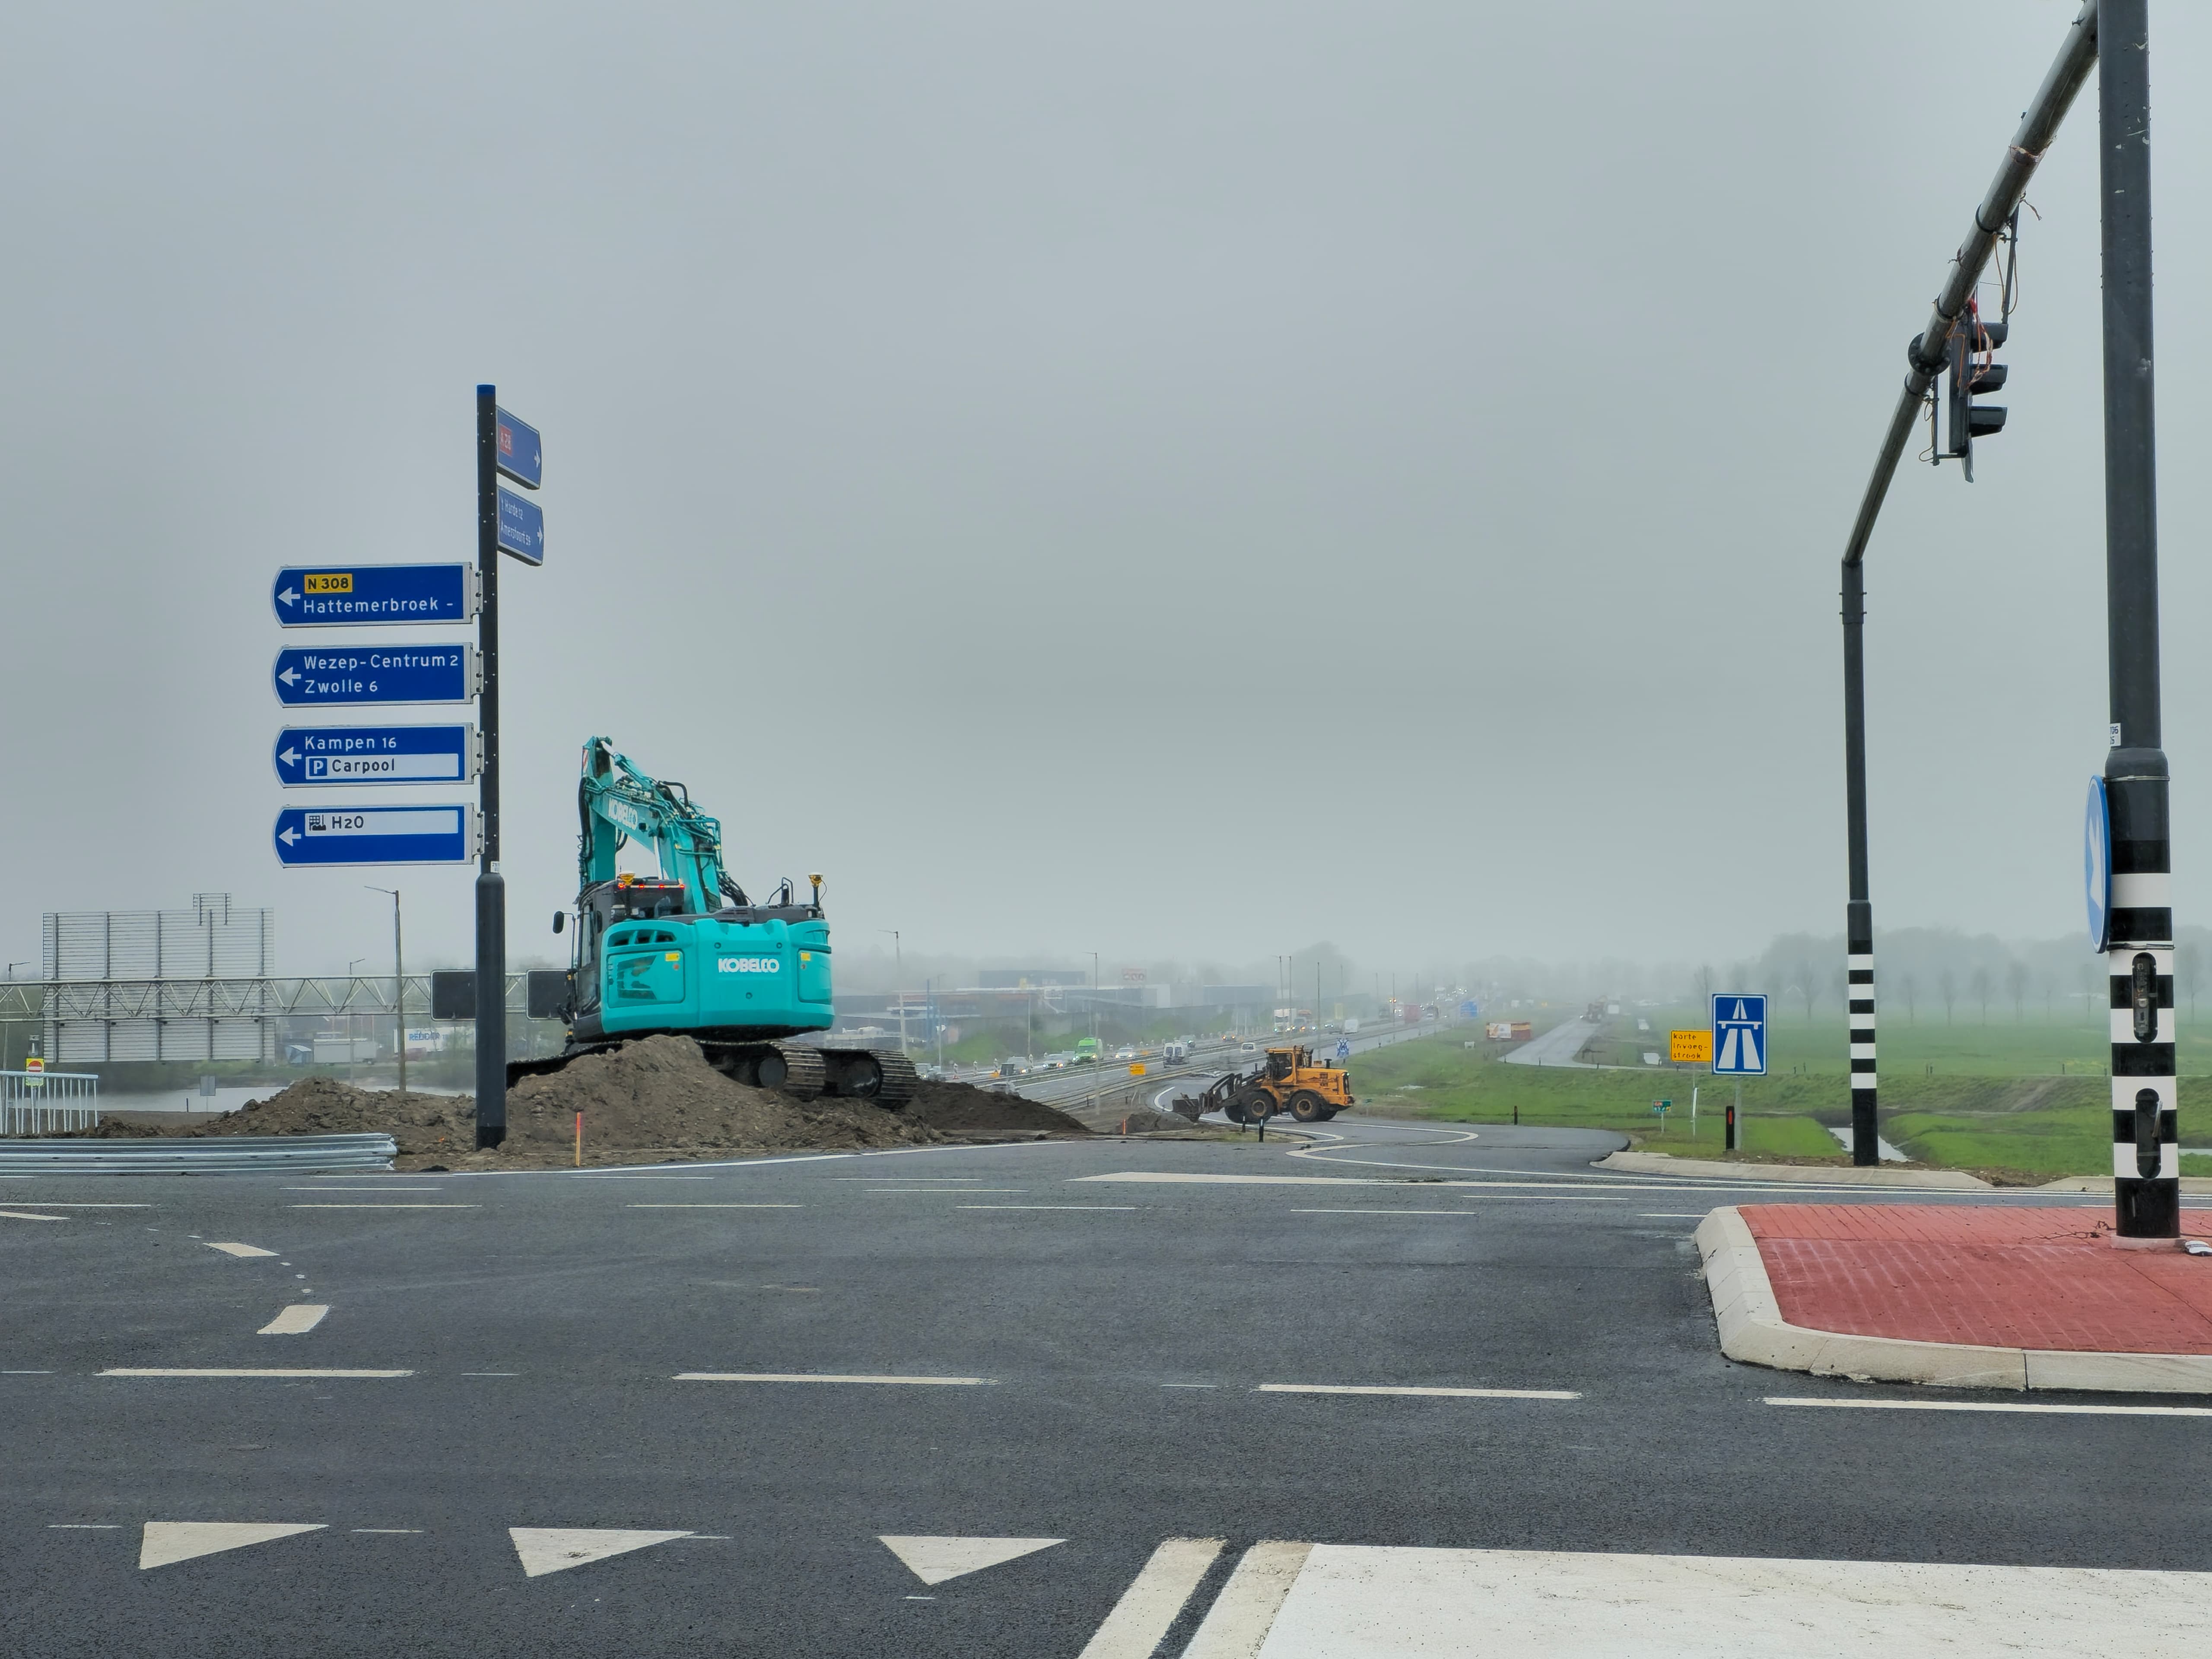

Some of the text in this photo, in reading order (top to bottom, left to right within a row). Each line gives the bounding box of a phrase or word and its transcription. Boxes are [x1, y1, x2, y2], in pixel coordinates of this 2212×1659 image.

[308, 577, 349, 590] N 308
[304, 597, 439, 613] Hattemerbroek
[305, 654, 458, 671] Wezep-Centrum 2
[305, 679, 378, 694] Zwolle 6
[305, 736, 397, 752] Kampen 16
[313, 758, 394, 774] P Carpool
[608, 797, 638, 830] KOBELCO
[718, 958, 780, 973] KOBELCO
